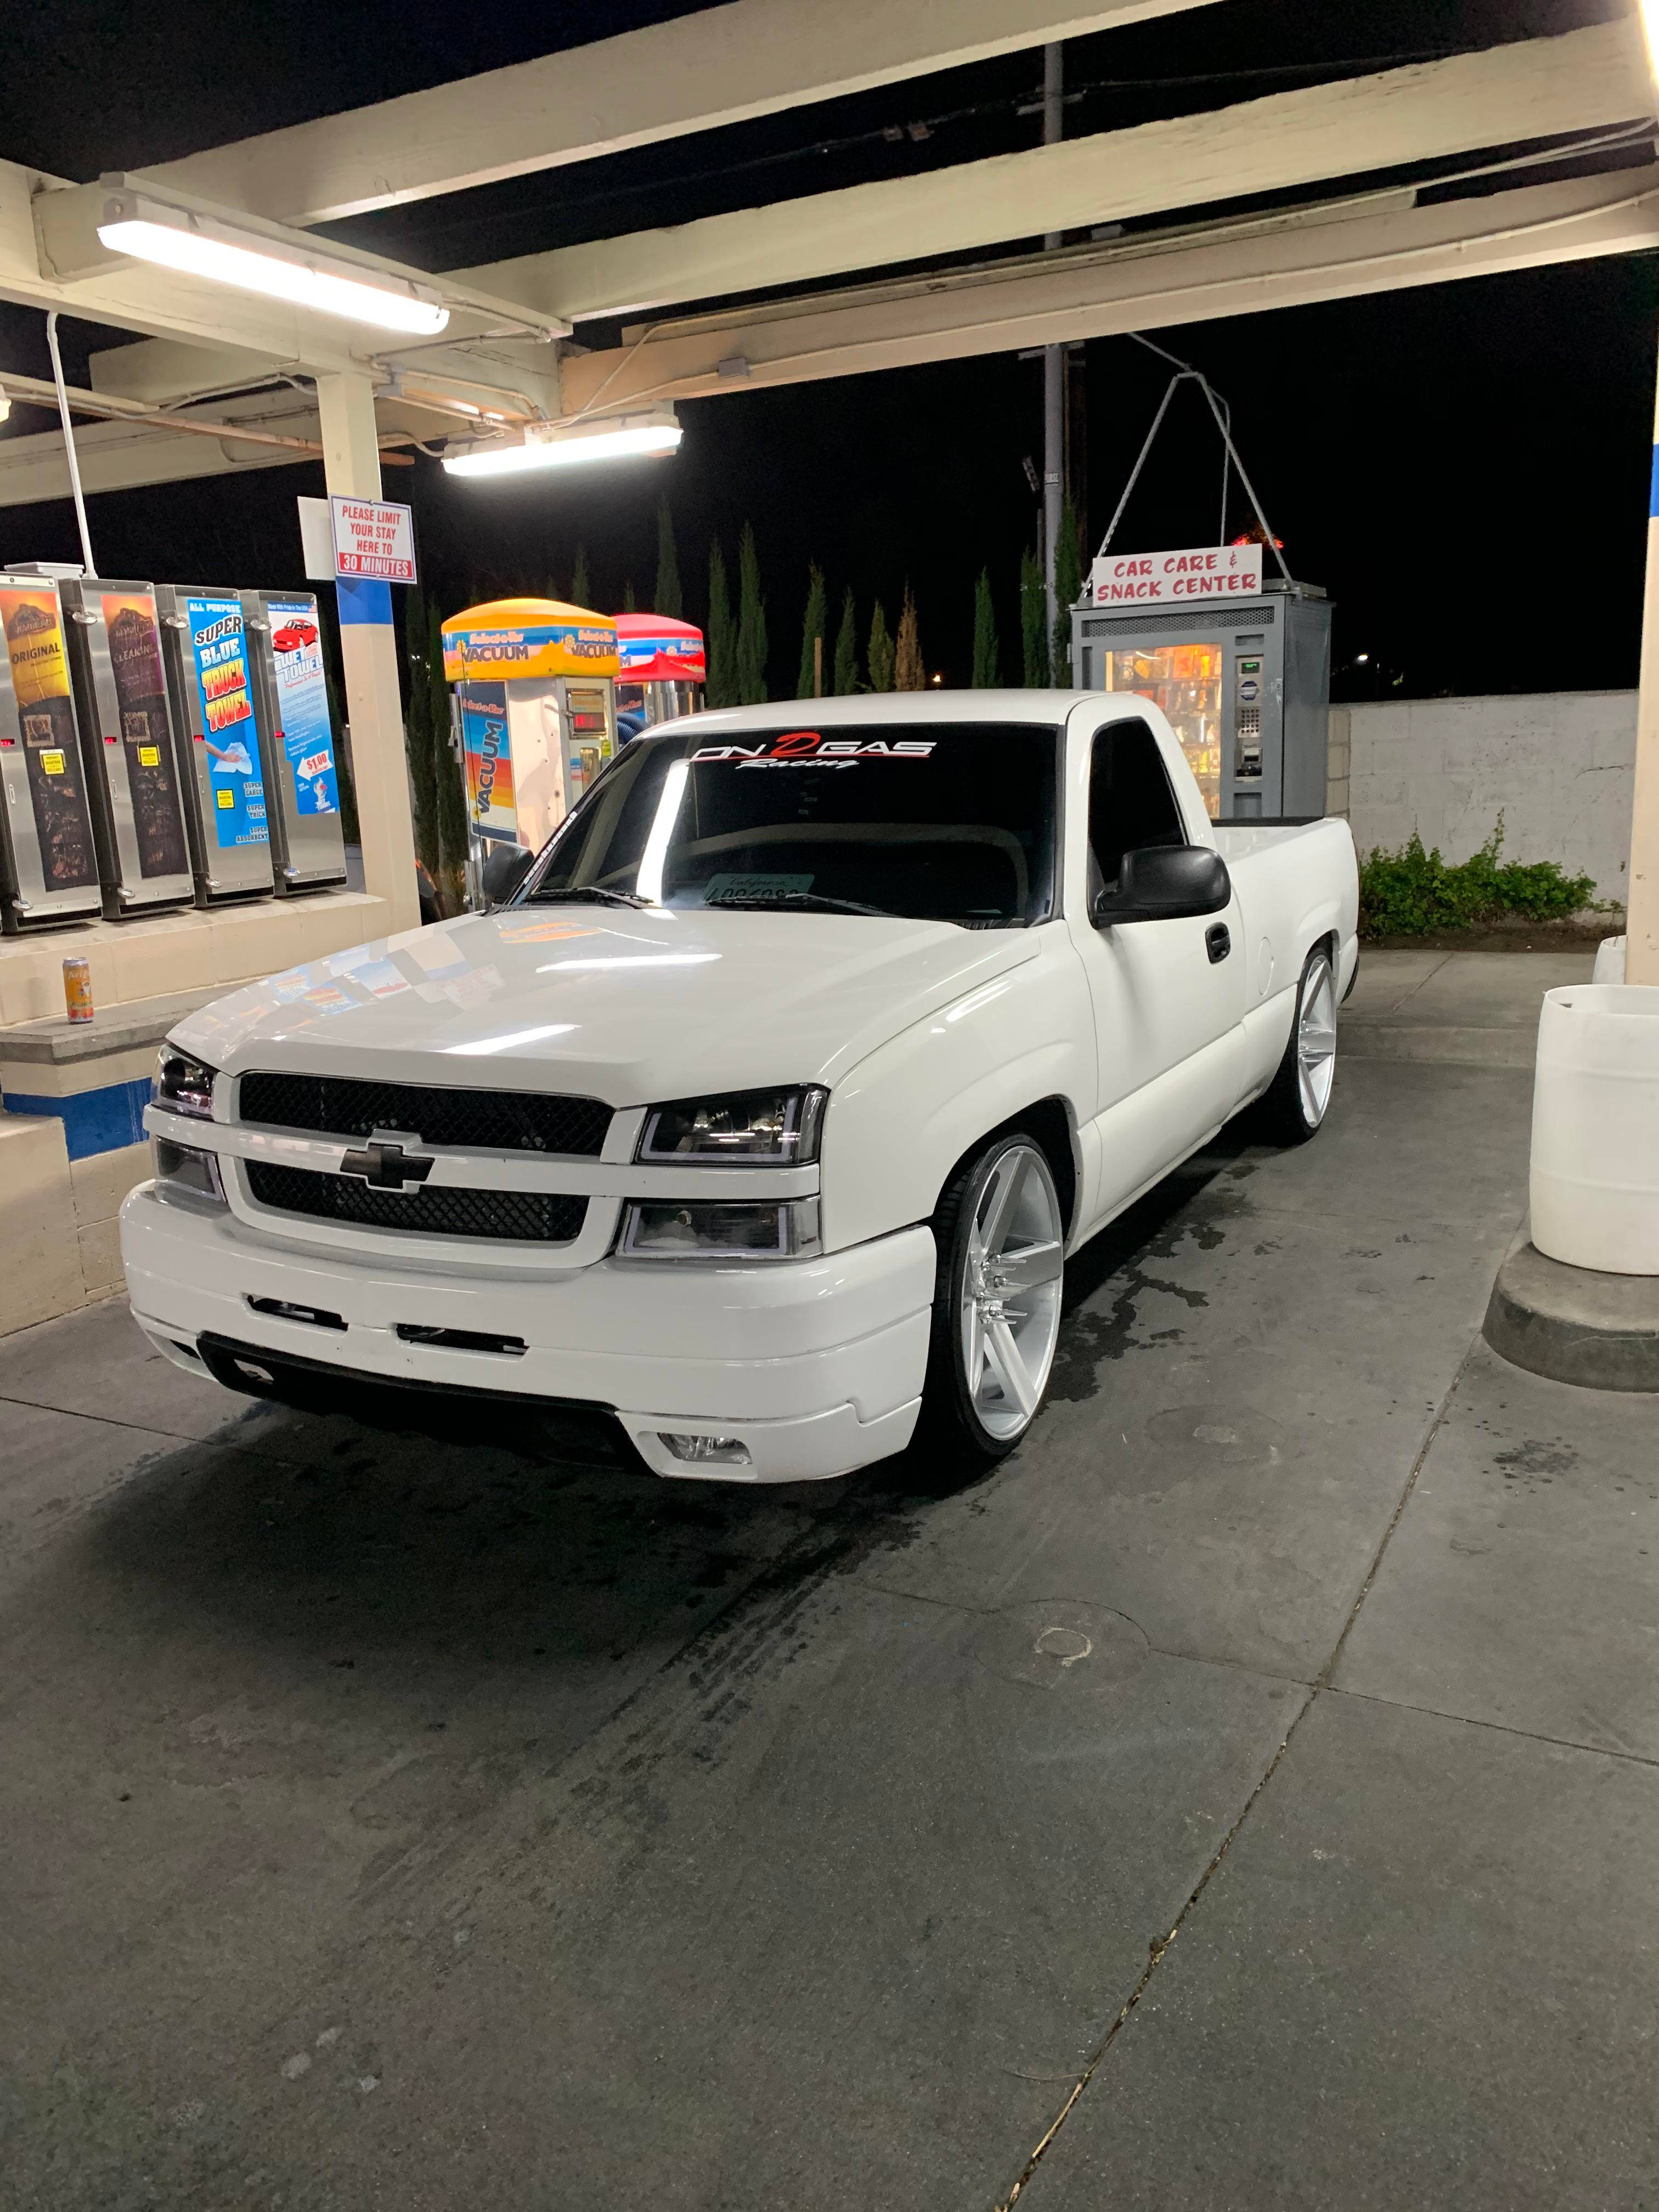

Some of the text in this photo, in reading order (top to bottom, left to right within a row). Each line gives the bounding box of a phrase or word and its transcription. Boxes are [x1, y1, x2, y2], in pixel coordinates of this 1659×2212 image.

[342, 505, 401, 525] PLEASE LIMIT
[350, 523, 396, 540] YOUR STAY
[357, 540, 393, 555] HERE TO
[343, 554, 409, 576] 30 MINUTES
[1114, 550, 1238, 577] CAR CARE &
[1097, 573, 1256, 601] SNACK CENTER
[189, 602, 241, 613] ALL PURPOSE
[195, 615, 242, 645] SUPER
[12, 642, 60, 664] ORIGINAL
[200, 637, 241, 669] BLUE
[275, 646, 307, 671] WET
[463, 645, 529, 663] VACUUM
[572, 643, 617, 658] VACUUM
[201, 658, 246, 700] TRUCK
[275, 654, 324, 683] TOWEL
[205, 689, 252, 732] TOWEL
[816, 741, 937, 755] GAS
[307, 753, 327, 770] $1.00
[477, 720, 503, 813] VACUUM
[735, 758, 860, 769] Racing
[237, 833, 268, 842] ABSORBENT
